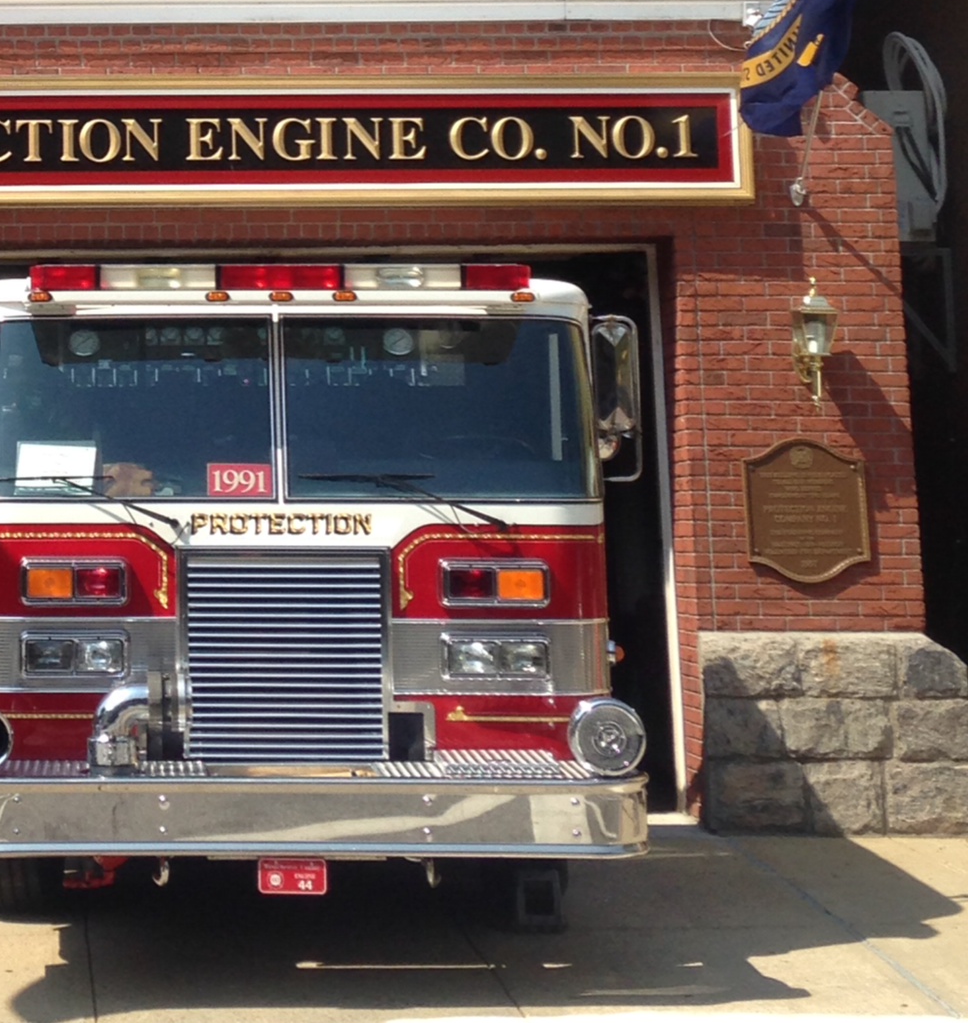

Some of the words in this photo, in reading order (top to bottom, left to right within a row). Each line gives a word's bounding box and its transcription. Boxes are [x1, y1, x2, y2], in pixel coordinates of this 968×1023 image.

[185, 116, 427, 162] ENGINE
[448, 115, 548, 161] CO.
[569, 113, 699, 160] NO.1
[212, 469, 267, 494] 1991
[190, 512, 372, 536] PROTECTION
[298, 880, 313, 891] 44
